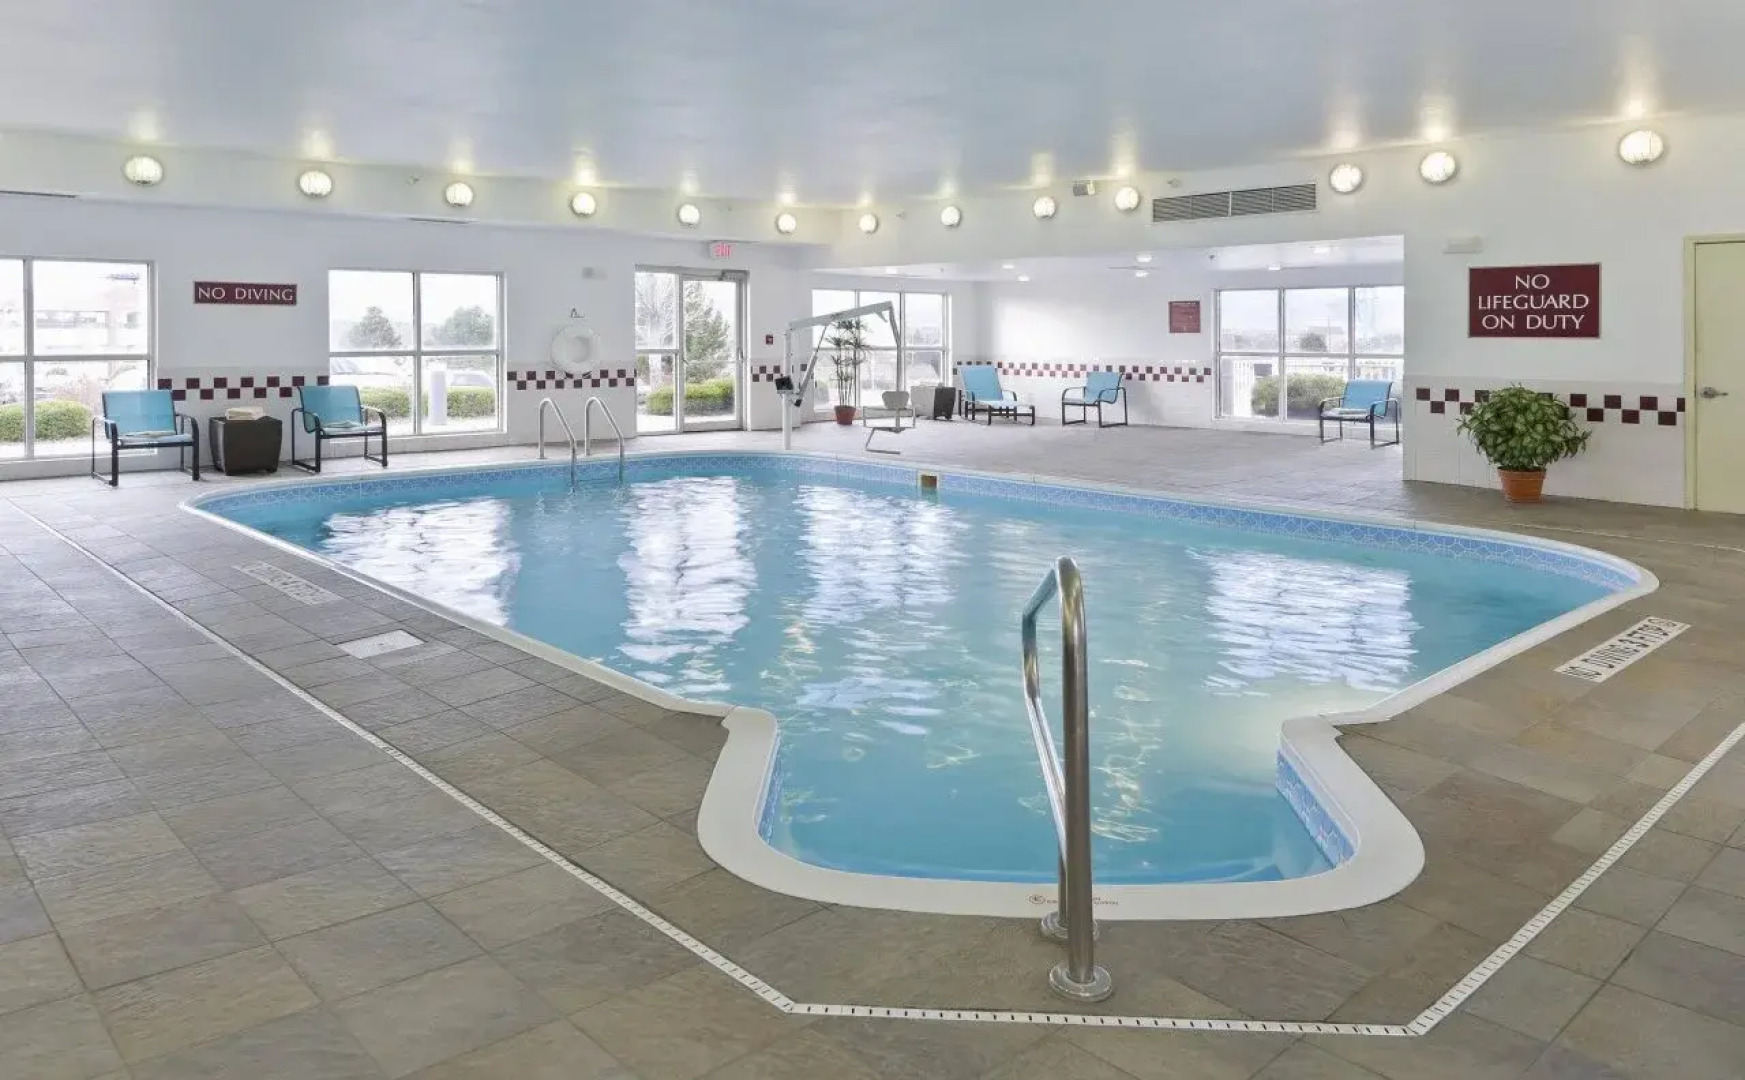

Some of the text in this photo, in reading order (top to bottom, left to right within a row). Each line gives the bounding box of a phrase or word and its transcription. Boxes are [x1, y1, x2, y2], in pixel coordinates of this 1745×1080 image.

[1515, 273, 1550, 290] NO
[198, 287, 293, 301] NO DIVING
[1478, 294, 1589, 310] LIFEGUARD
[1482, 314, 1585, 330] ON DUTY
